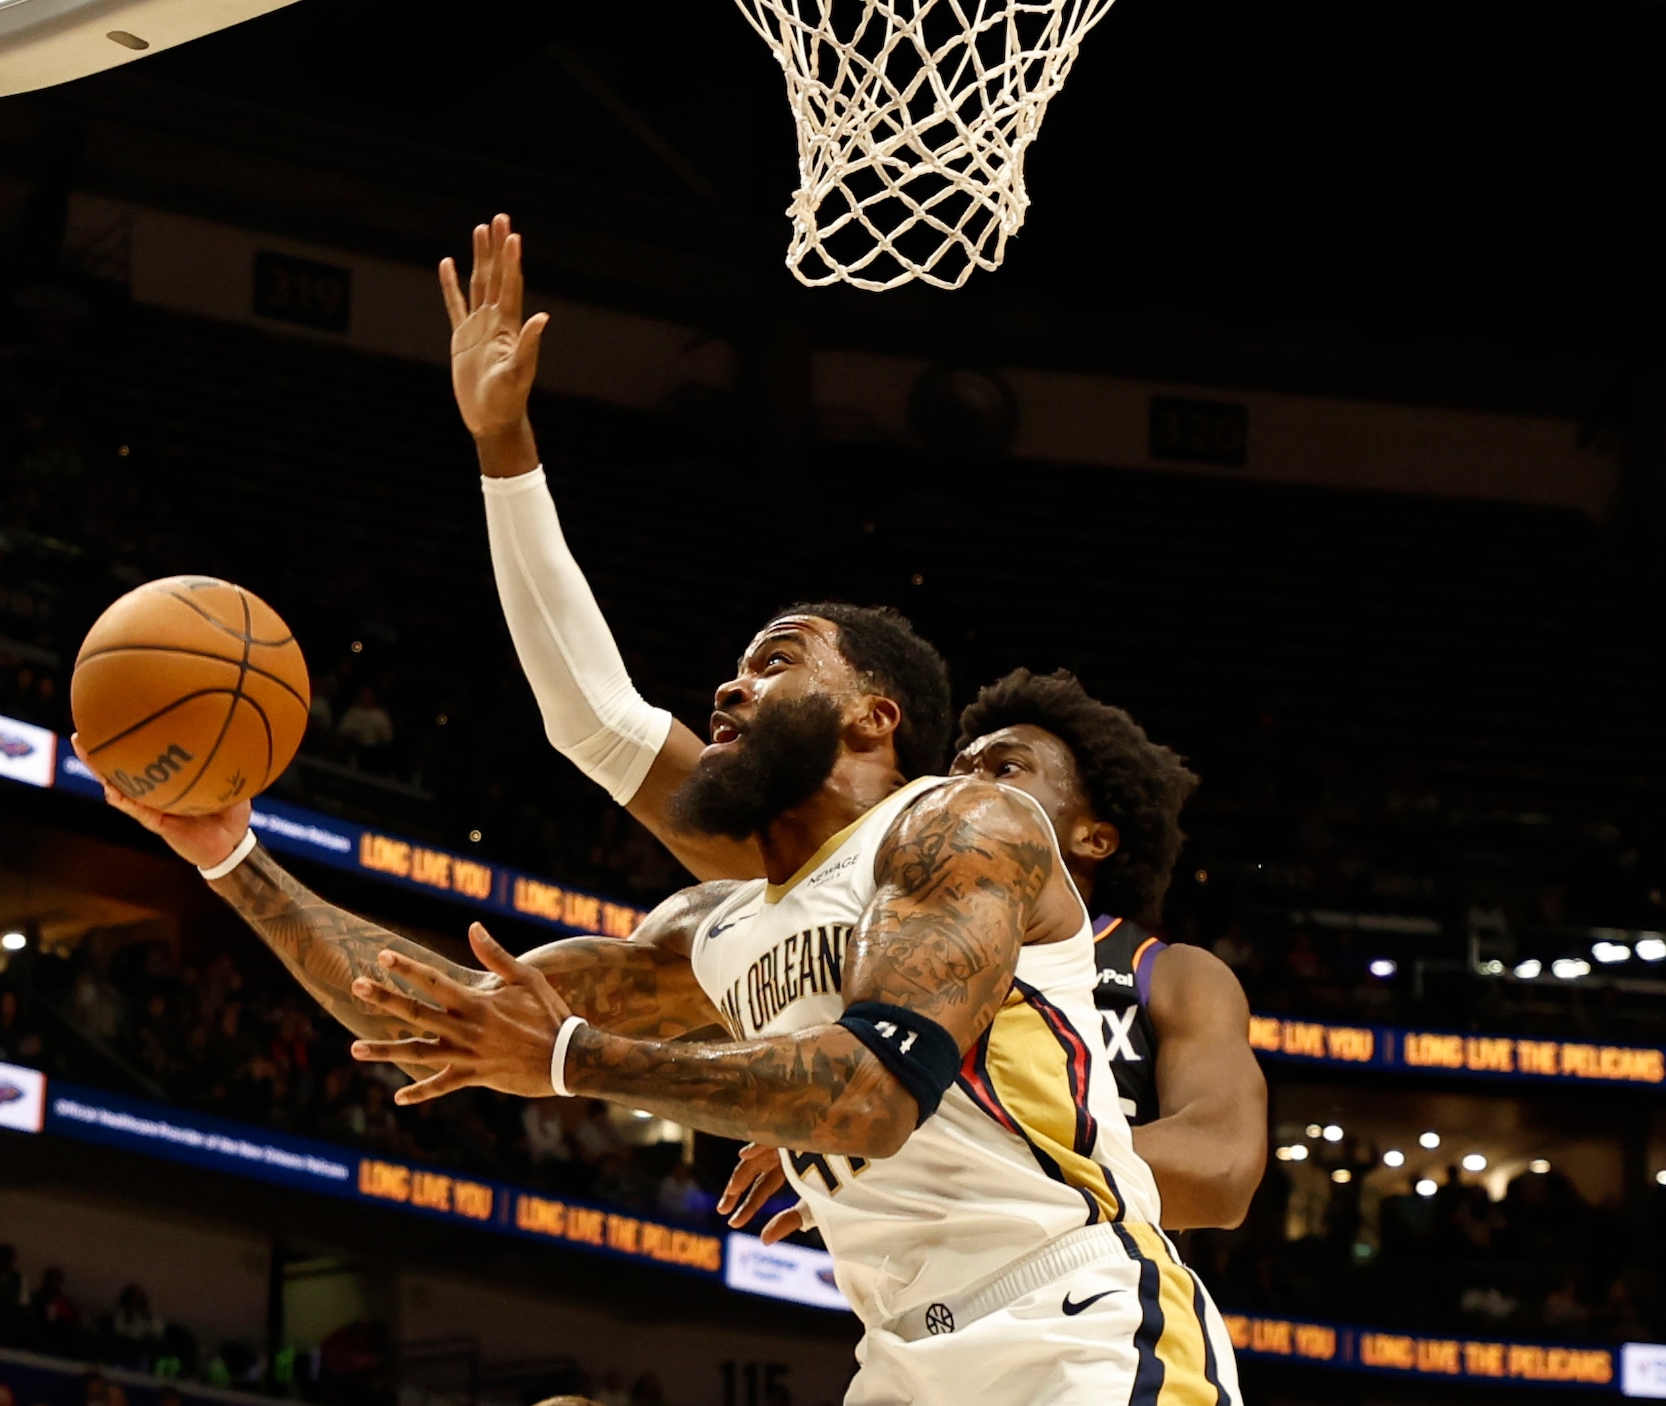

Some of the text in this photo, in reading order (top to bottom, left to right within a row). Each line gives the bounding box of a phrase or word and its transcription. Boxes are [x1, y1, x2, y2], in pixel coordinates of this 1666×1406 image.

[359, 831, 492, 900] LONG LIVE YOU
[514, 876, 563, 921] LONG
[563, 889, 601, 934] LIVE
[1281, 1020, 1326, 1058] LIVE
[1327, 1026, 1374, 1062] YOU
[1404, 1033, 1463, 1069] LONG
[1465, 1037, 1514, 1073] LIVE
[1516, 1039, 1558, 1075] THE
[1559, 1043, 1665, 1083] PELICANS
[358, 1157, 493, 1220] LONG LIVE YOU
[515, 1193, 722, 1272] LONG LIVE THE PELICANS
[1252, 1319, 1293, 1356] LIVE
[1294, 1323, 1336, 1361] YOU
[1360, 1333, 1414, 1370] LONG
[1415, 1339, 1461, 1374] LIVE
[1463, 1342, 1506, 1377] THE
[1507, 1344, 1612, 1384] PELICANS
